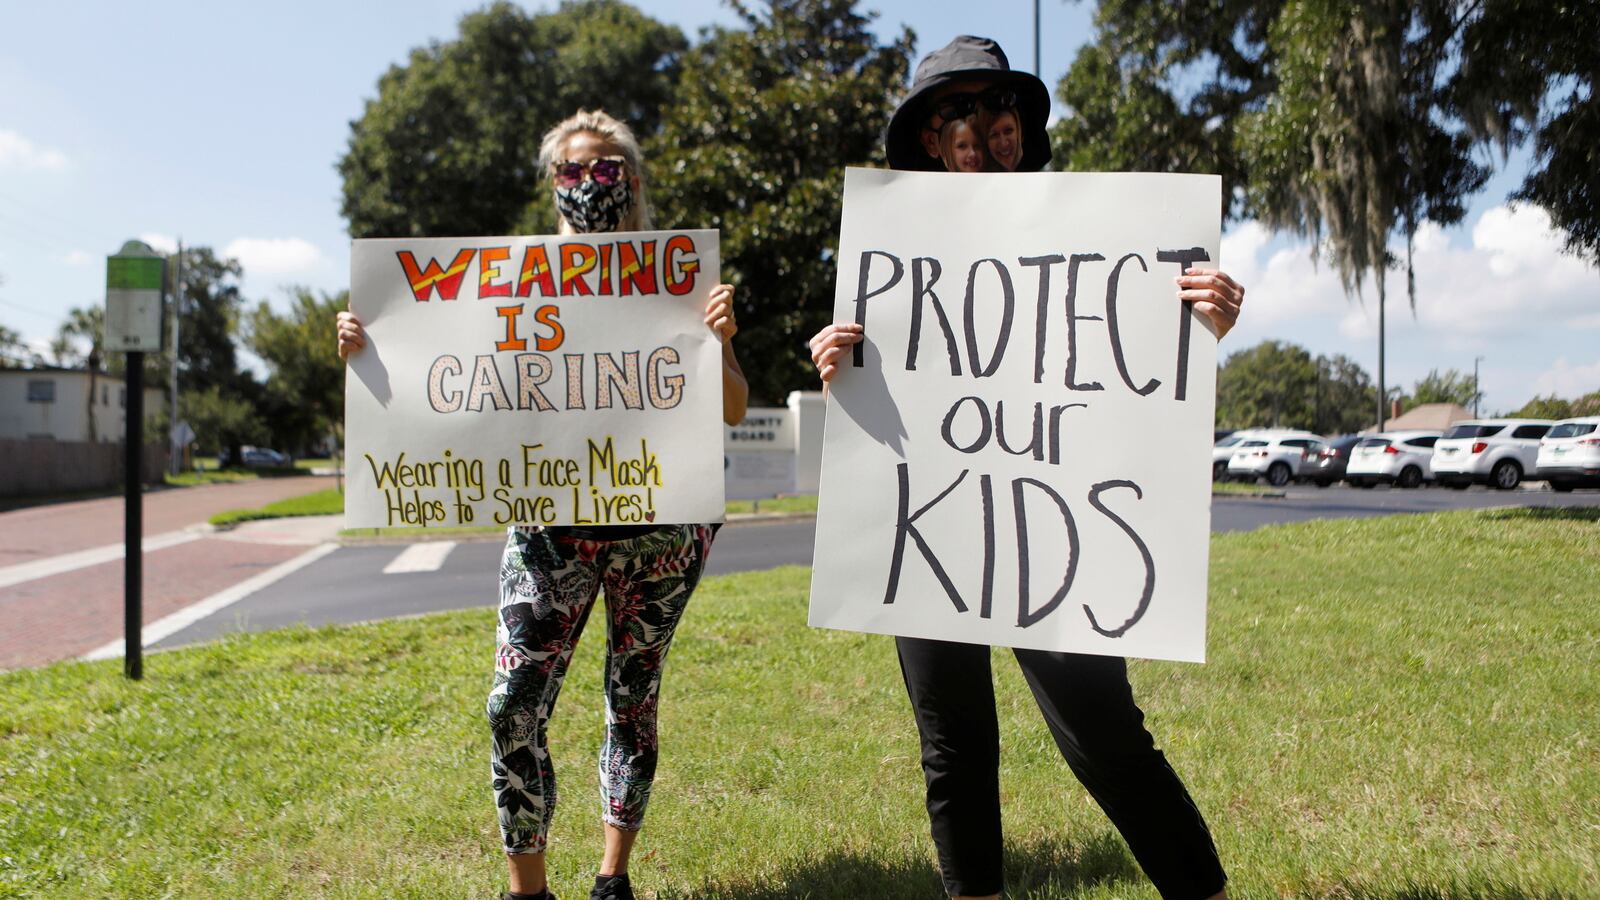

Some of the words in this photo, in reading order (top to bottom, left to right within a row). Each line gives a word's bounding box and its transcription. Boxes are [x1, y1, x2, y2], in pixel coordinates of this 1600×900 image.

[396, 234, 701, 302] WEARING
[495, 303, 565, 352] IS
[852, 246, 1211, 401] PROTECT
[427, 346, 686, 413] CARING
[731, 431, 775, 441] BOARD
[741, 418, 783, 427] OUNTY
[941, 396, 1088, 465] our
[365, 450, 486, 501] Wearing
[500, 458, 514, 488] a
[521, 443, 582, 488] Face
[588, 437, 662, 488] Mask
[385, 487, 446, 527] Helps
[453, 489, 474, 524] to
[494, 489, 556, 524] Save
[574, 487, 656, 524] Lives!
[883, 462, 1156, 639] KIDS
